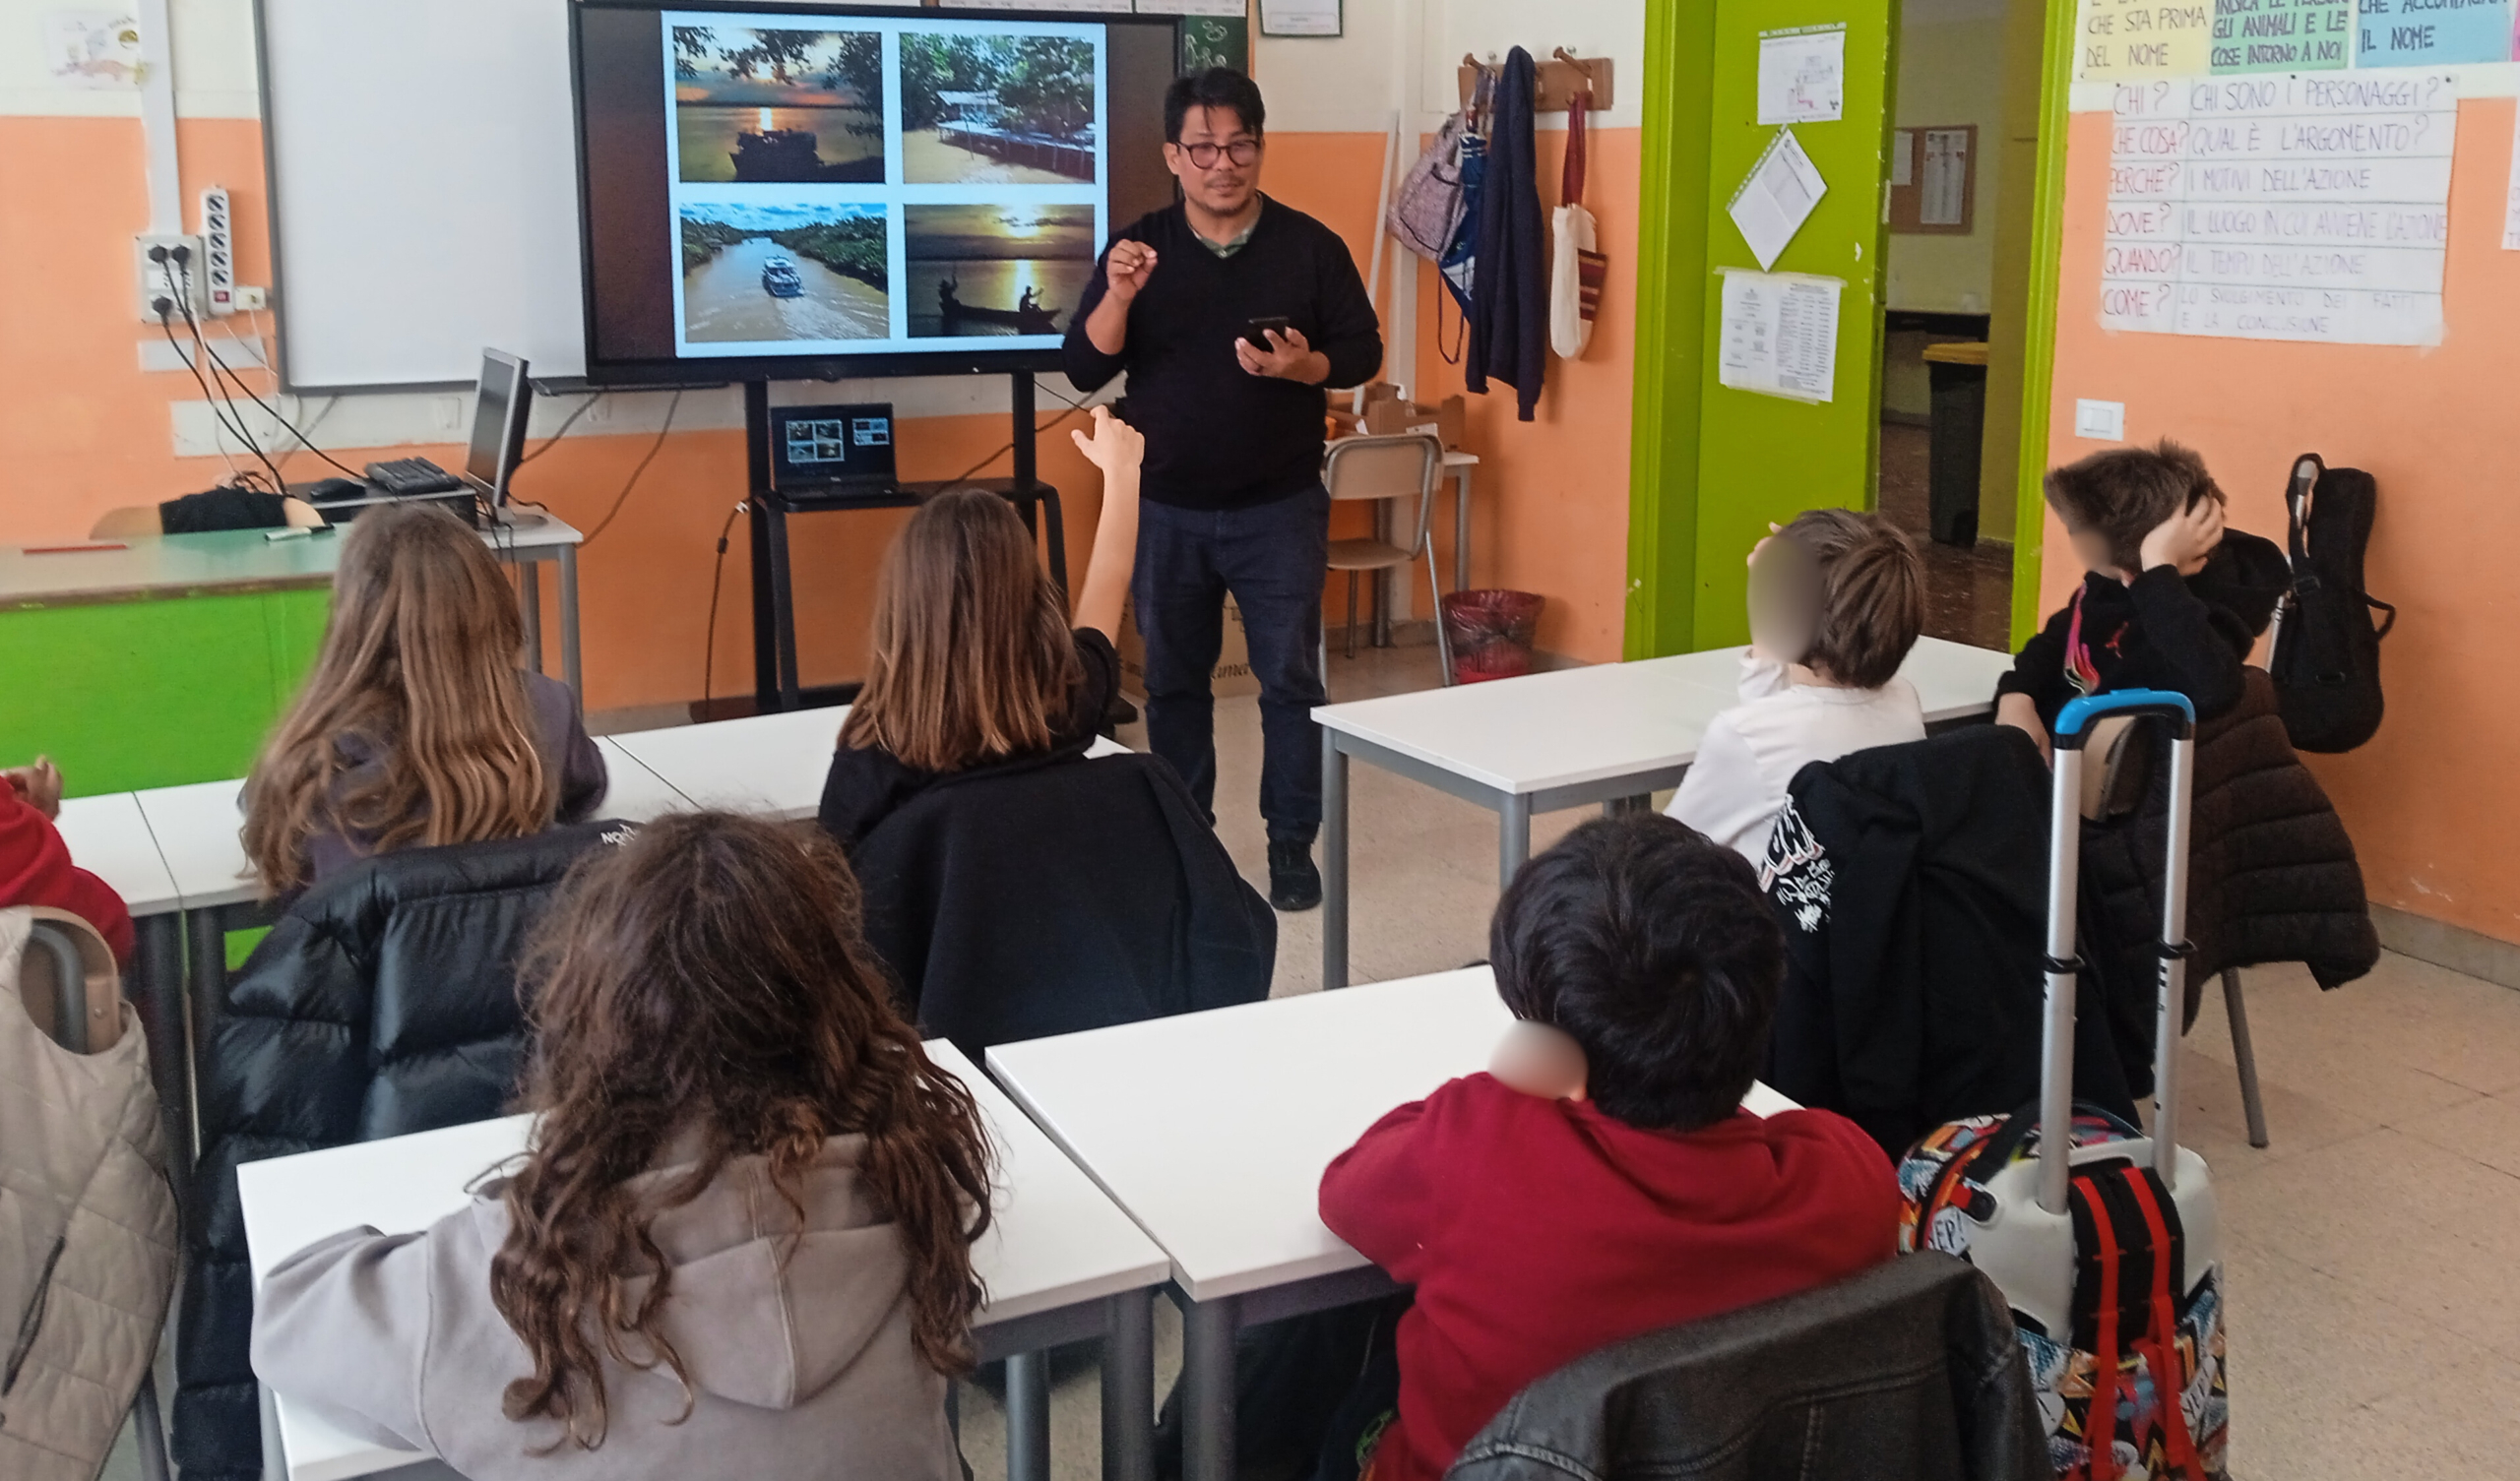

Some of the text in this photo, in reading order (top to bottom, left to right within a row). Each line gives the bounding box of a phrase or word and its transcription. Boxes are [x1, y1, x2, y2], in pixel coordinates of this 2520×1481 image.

[2088, 6, 2207, 34] CHE STA PRIMA
[2242, 12, 2297, 37] ANIMALI
[2304, 13, 2316, 34] E
[2326, 11, 2349, 31] LE
[2362, 25, 2435, 53] IL NOME
[2086, 42, 2169, 68] DEL NOME
[2211, 40, 2342, 67] COSE INTORNO A NOI
[2191, 84, 2218, 110] CHI
[2225, 82, 2276, 110] SONO
[2192, 127, 2239, 155] QUAL
[2247, 122, 2261, 152] È
[2262, 167, 2371, 192] DELL'AZIONE
[2209, 210, 2256, 234] LUOGO
